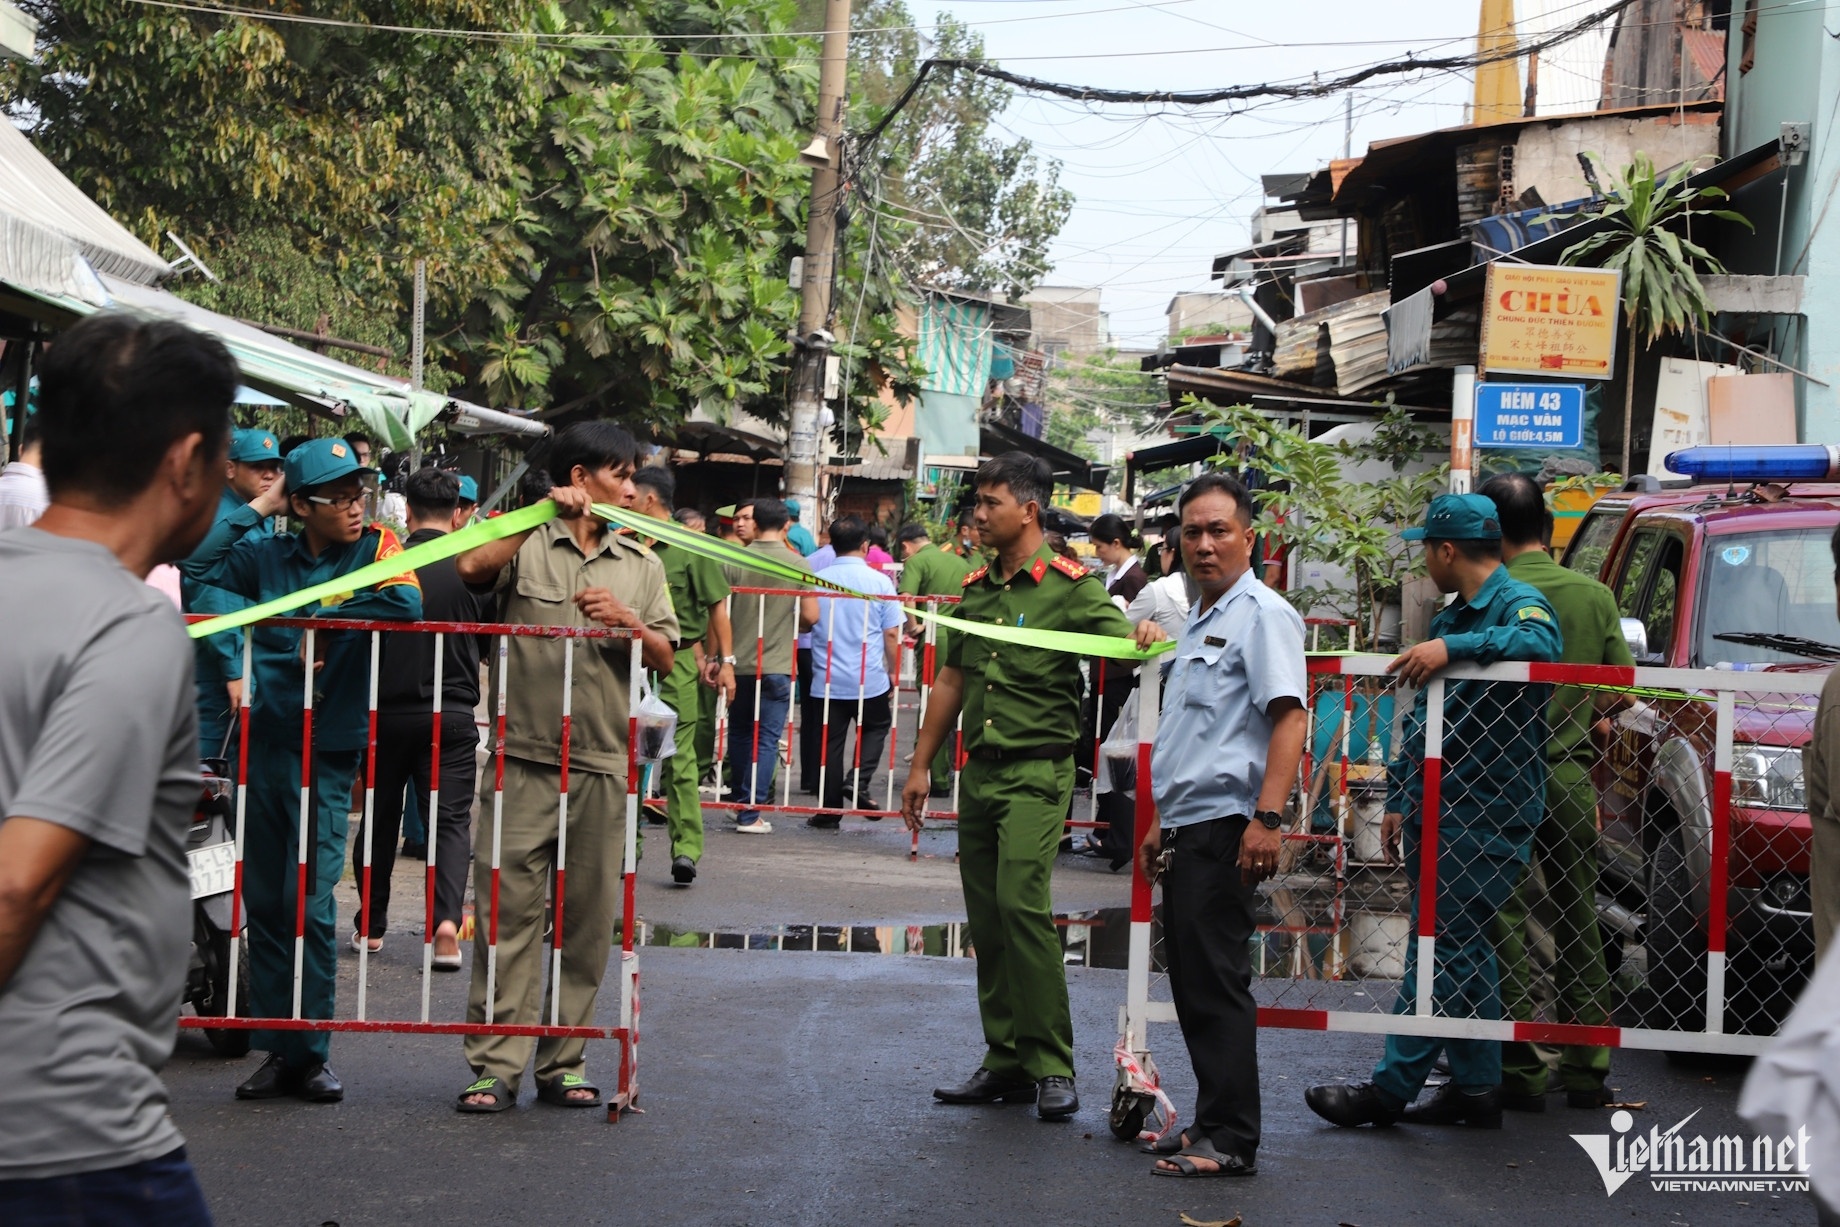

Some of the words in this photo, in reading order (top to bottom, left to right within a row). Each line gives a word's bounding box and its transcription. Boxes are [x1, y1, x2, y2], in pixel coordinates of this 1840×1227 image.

[1522, 274, 1535, 284] HỘI
[1499, 287, 1605, 317] CHÙA
[1500, 387, 1535, 410] HẺM
[1539, 392, 1561, 411] 43
[1497, 414, 1530, 428] MẠC
[1533, 412, 1562, 426] VÂN
[1493, 428, 1507, 442] LỘ
